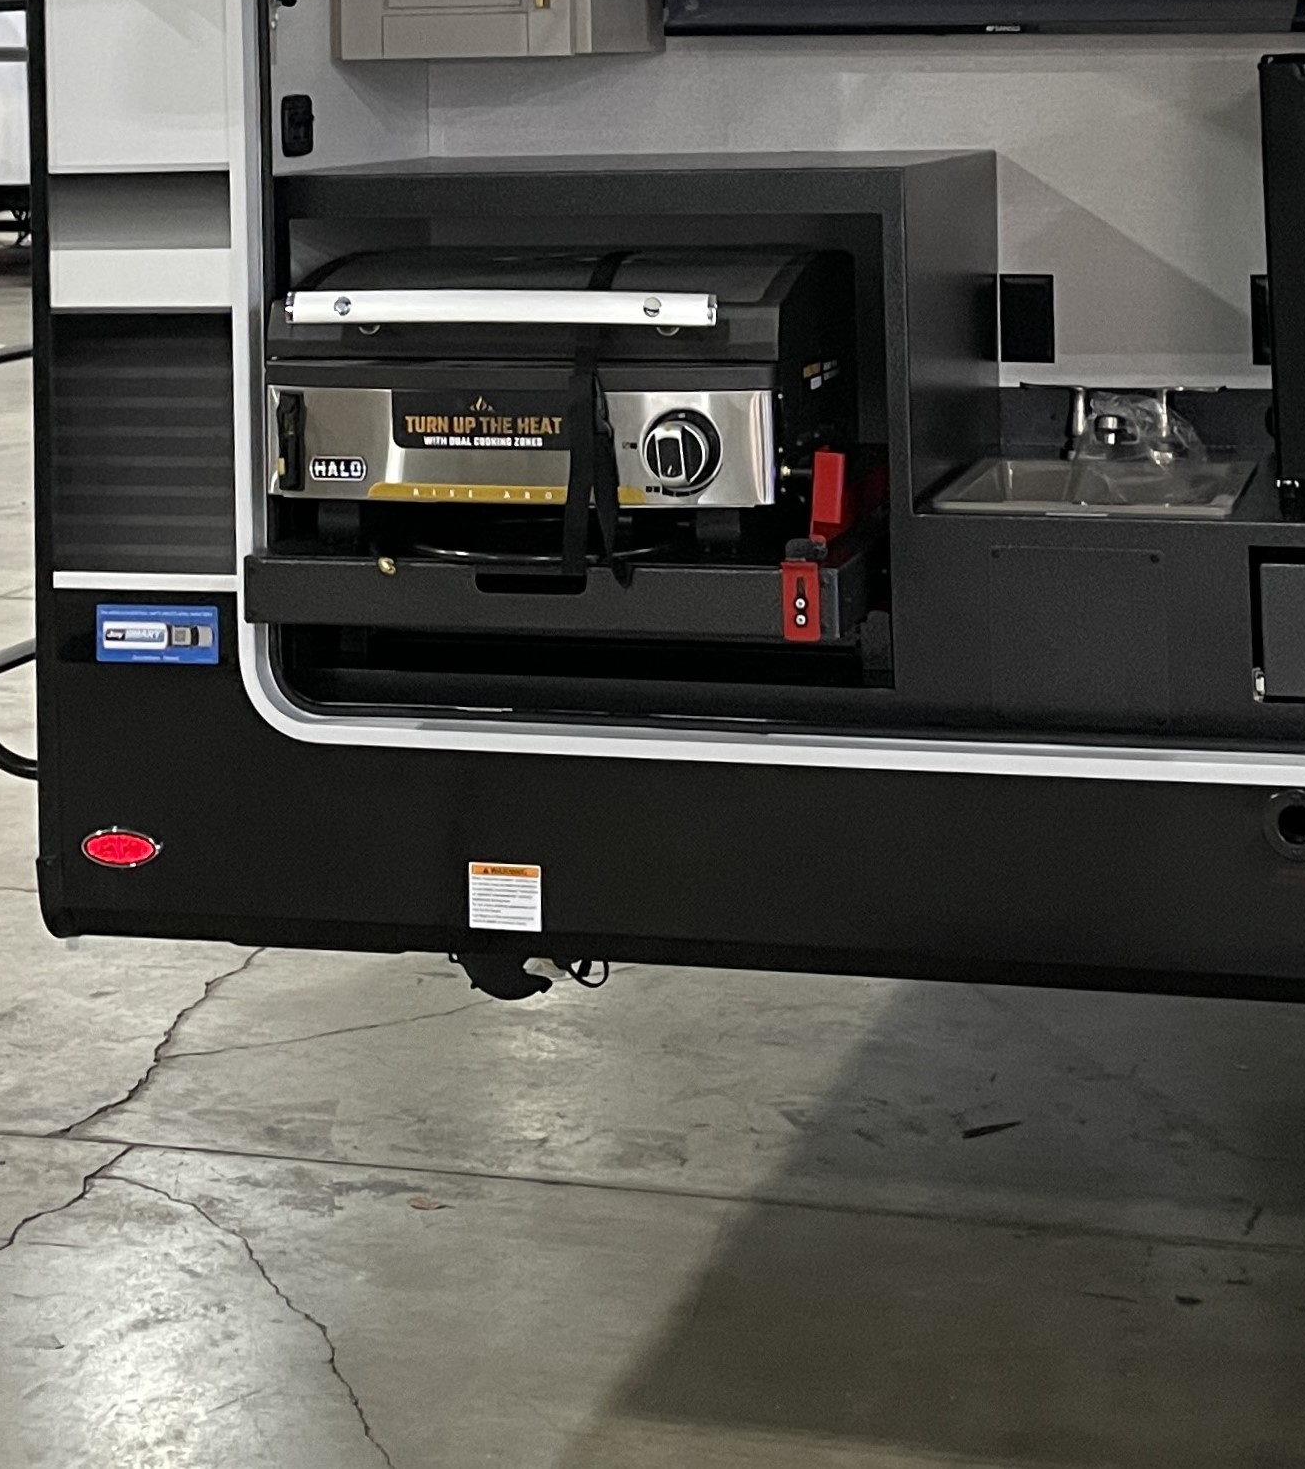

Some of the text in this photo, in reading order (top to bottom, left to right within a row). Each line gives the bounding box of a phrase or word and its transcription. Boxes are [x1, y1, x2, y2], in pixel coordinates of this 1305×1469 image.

[405, 415, 562, 435] TURN UP THE HEAT
[424, 436, 543, 447] WITH DUAL COOKING ZONES
[314, 461, 364, 478] HALO
